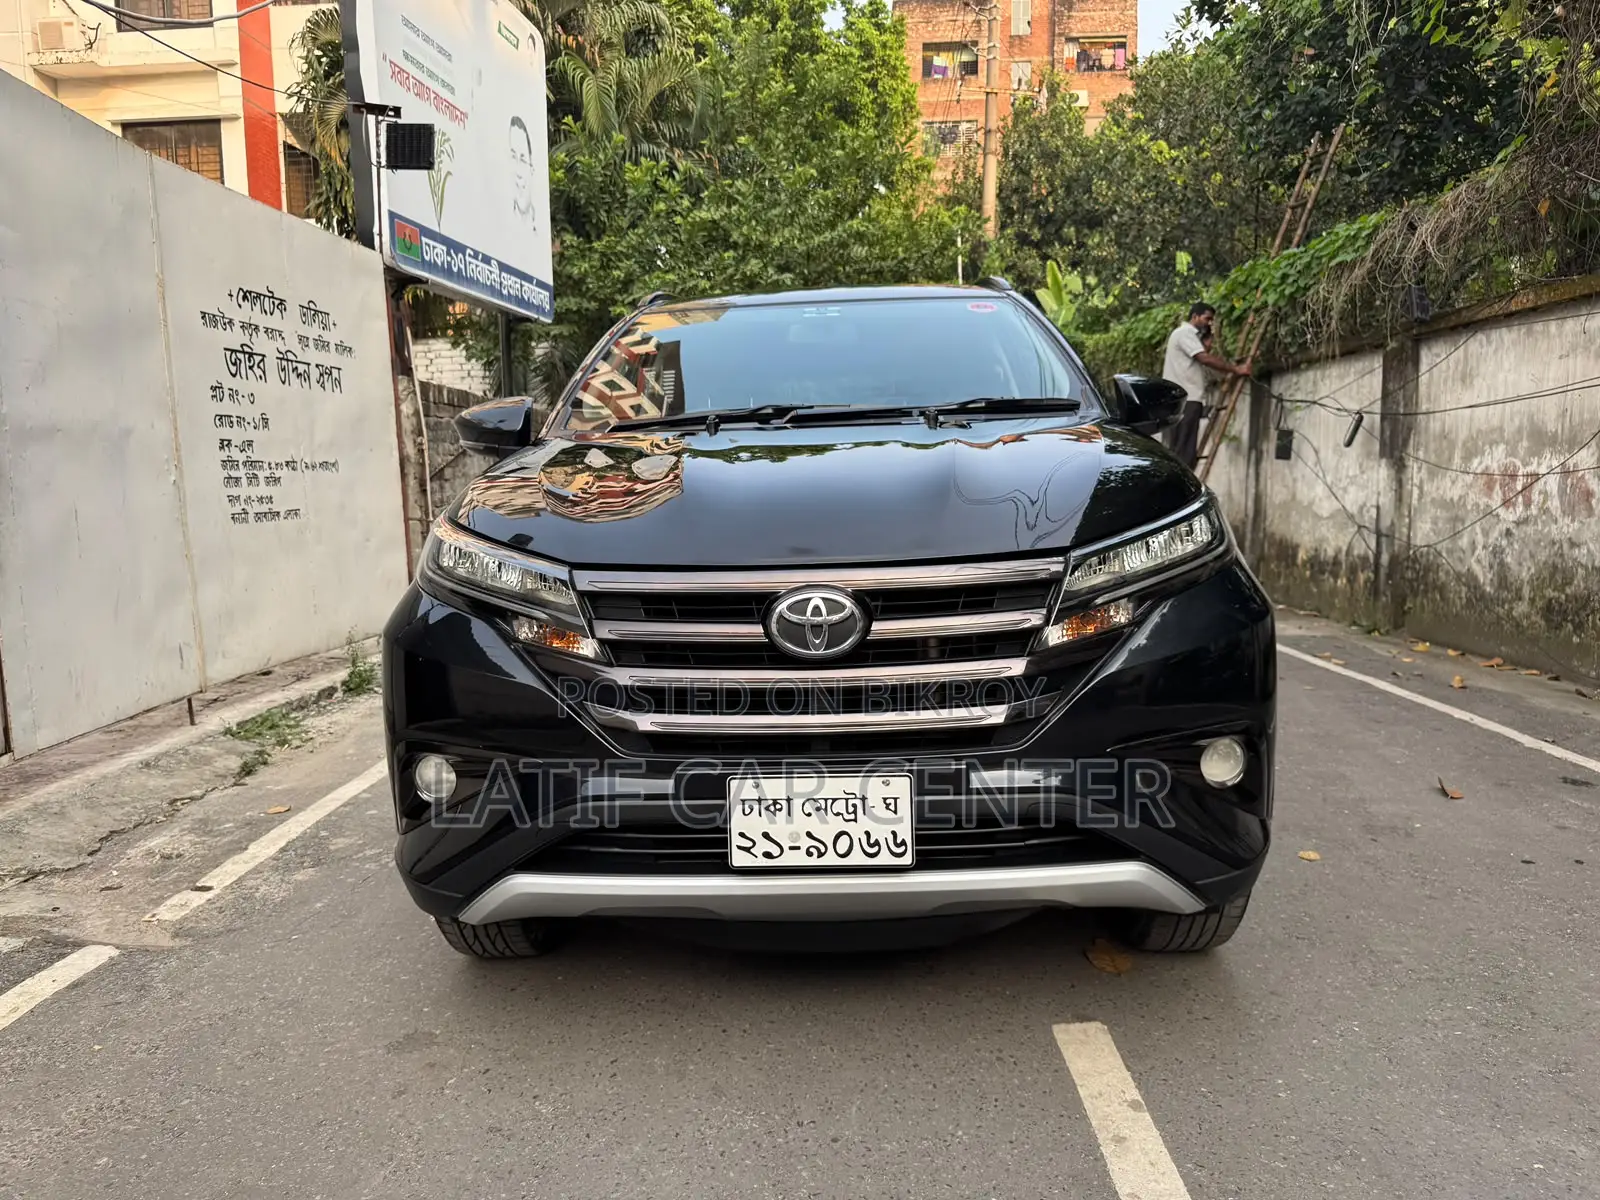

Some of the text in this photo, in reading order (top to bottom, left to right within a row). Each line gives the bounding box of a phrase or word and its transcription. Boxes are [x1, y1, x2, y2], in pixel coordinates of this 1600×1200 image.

[411, 75, 432, 107] আগে
[421, 236, 550, 312] ঢাকা-১৭ নির্বাচনী প্রধান কার্যালয়
[200, 307, 235, 333] রাজউক
[239, 316, 261, 345] কর্তৃক
[263, 326, 287, 346] বরাদ্দ
[223, 343, 343, 394] জহির উদ্দিন স্বপন
[210, 380, 225, 403] প্লট
[213, 414, 234, 429] রোড
[220, 455, 240, 472] জমির
[230, 508, 249, 524] বনানী
[740, 795, 794, 817] ঢাকা
[735, 830, 908, 860] ২১-৯০৬৬
